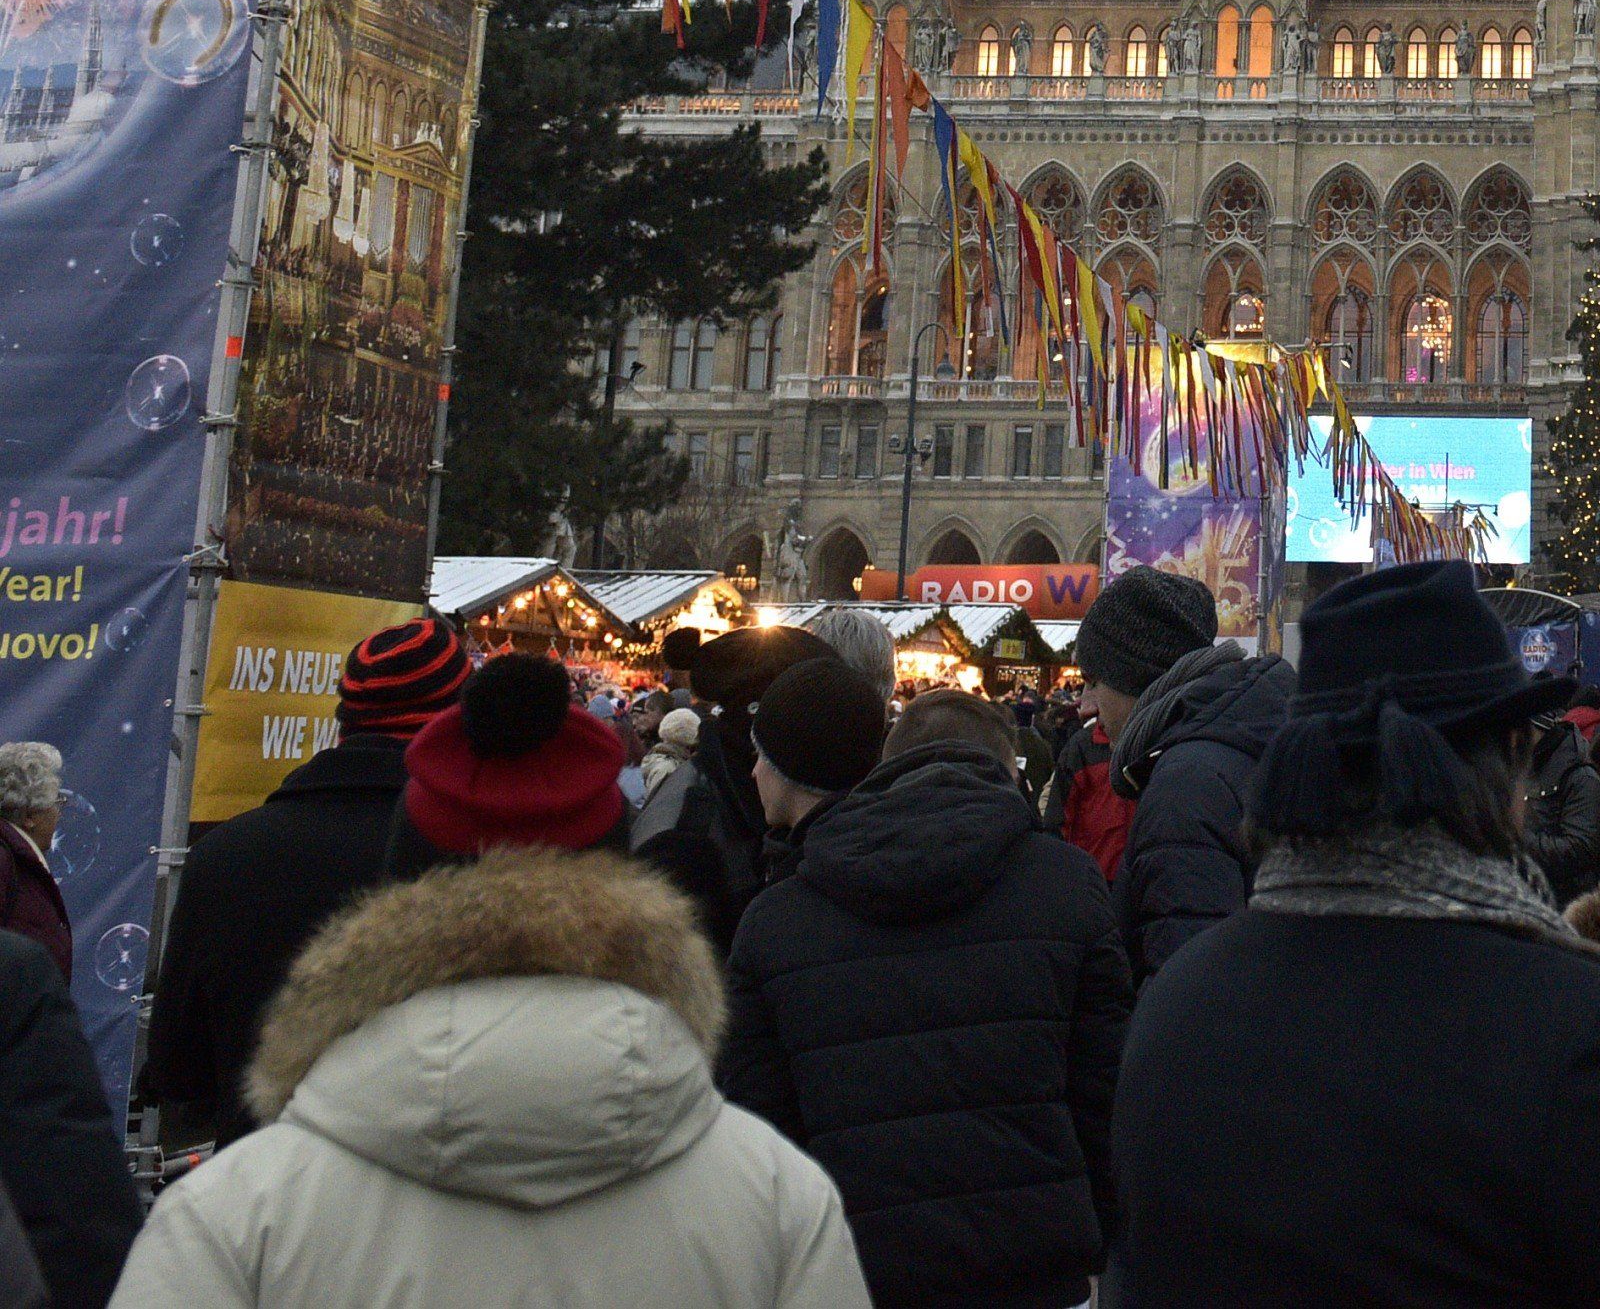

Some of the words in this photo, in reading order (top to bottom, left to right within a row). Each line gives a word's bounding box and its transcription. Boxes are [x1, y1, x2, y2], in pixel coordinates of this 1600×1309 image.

[921, 579, 1034, 604] RADIO
[228, 645, 277, 693] INS
[279, 649, 342, 695] NEUE
[261, 715, 308, 760] WIE
